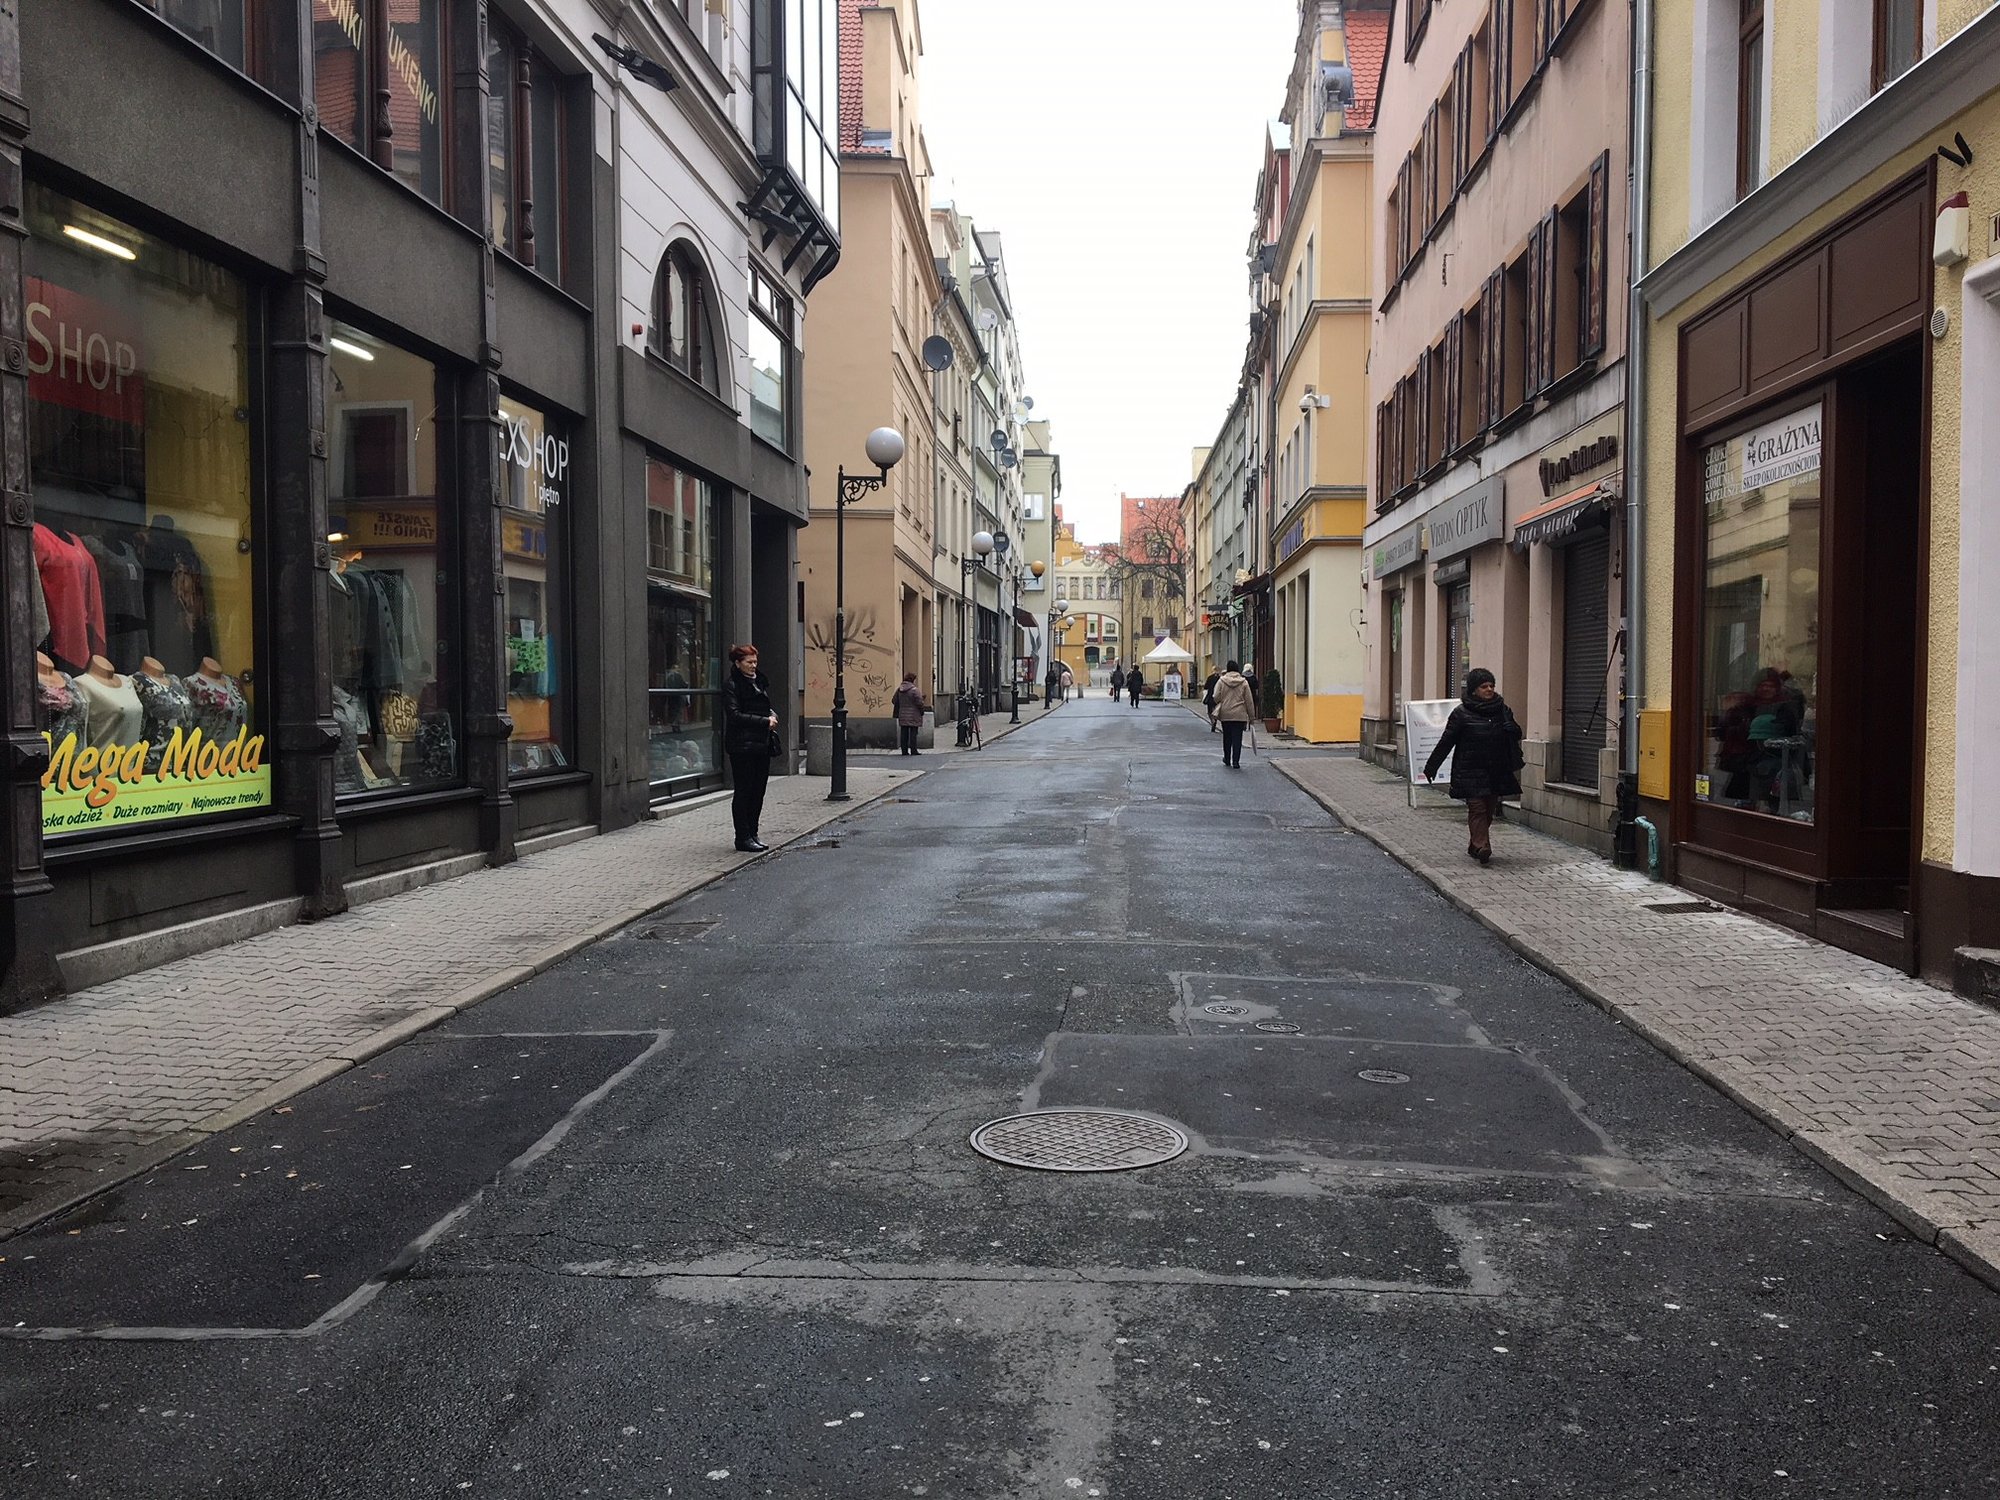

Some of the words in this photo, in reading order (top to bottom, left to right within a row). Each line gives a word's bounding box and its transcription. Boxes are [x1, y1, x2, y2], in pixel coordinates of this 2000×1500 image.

[387, 20, 437, 125] UKIENKI
[1993, 216, 2000, 242] 1
[25, 302, 136, 395] SHOP
[1758, 420, 1821, 464] GRAŻYNA
[539, 483, 560, 508] piętro
[1743, 473, 1762, 490] SKLEP
[1455, 496, 1488, 537] OPTYK
[155, 723, 265, 782] Moda
[42, 813, 65, 828] ska
[66, 809, 104, 825] odzież
[113, 803, 138, 819] Duże
[140, 800, 184, 817] rozmiary
[191, 794, 237, 812] Najnowsze
[238, 790, 264, 807] trendy
